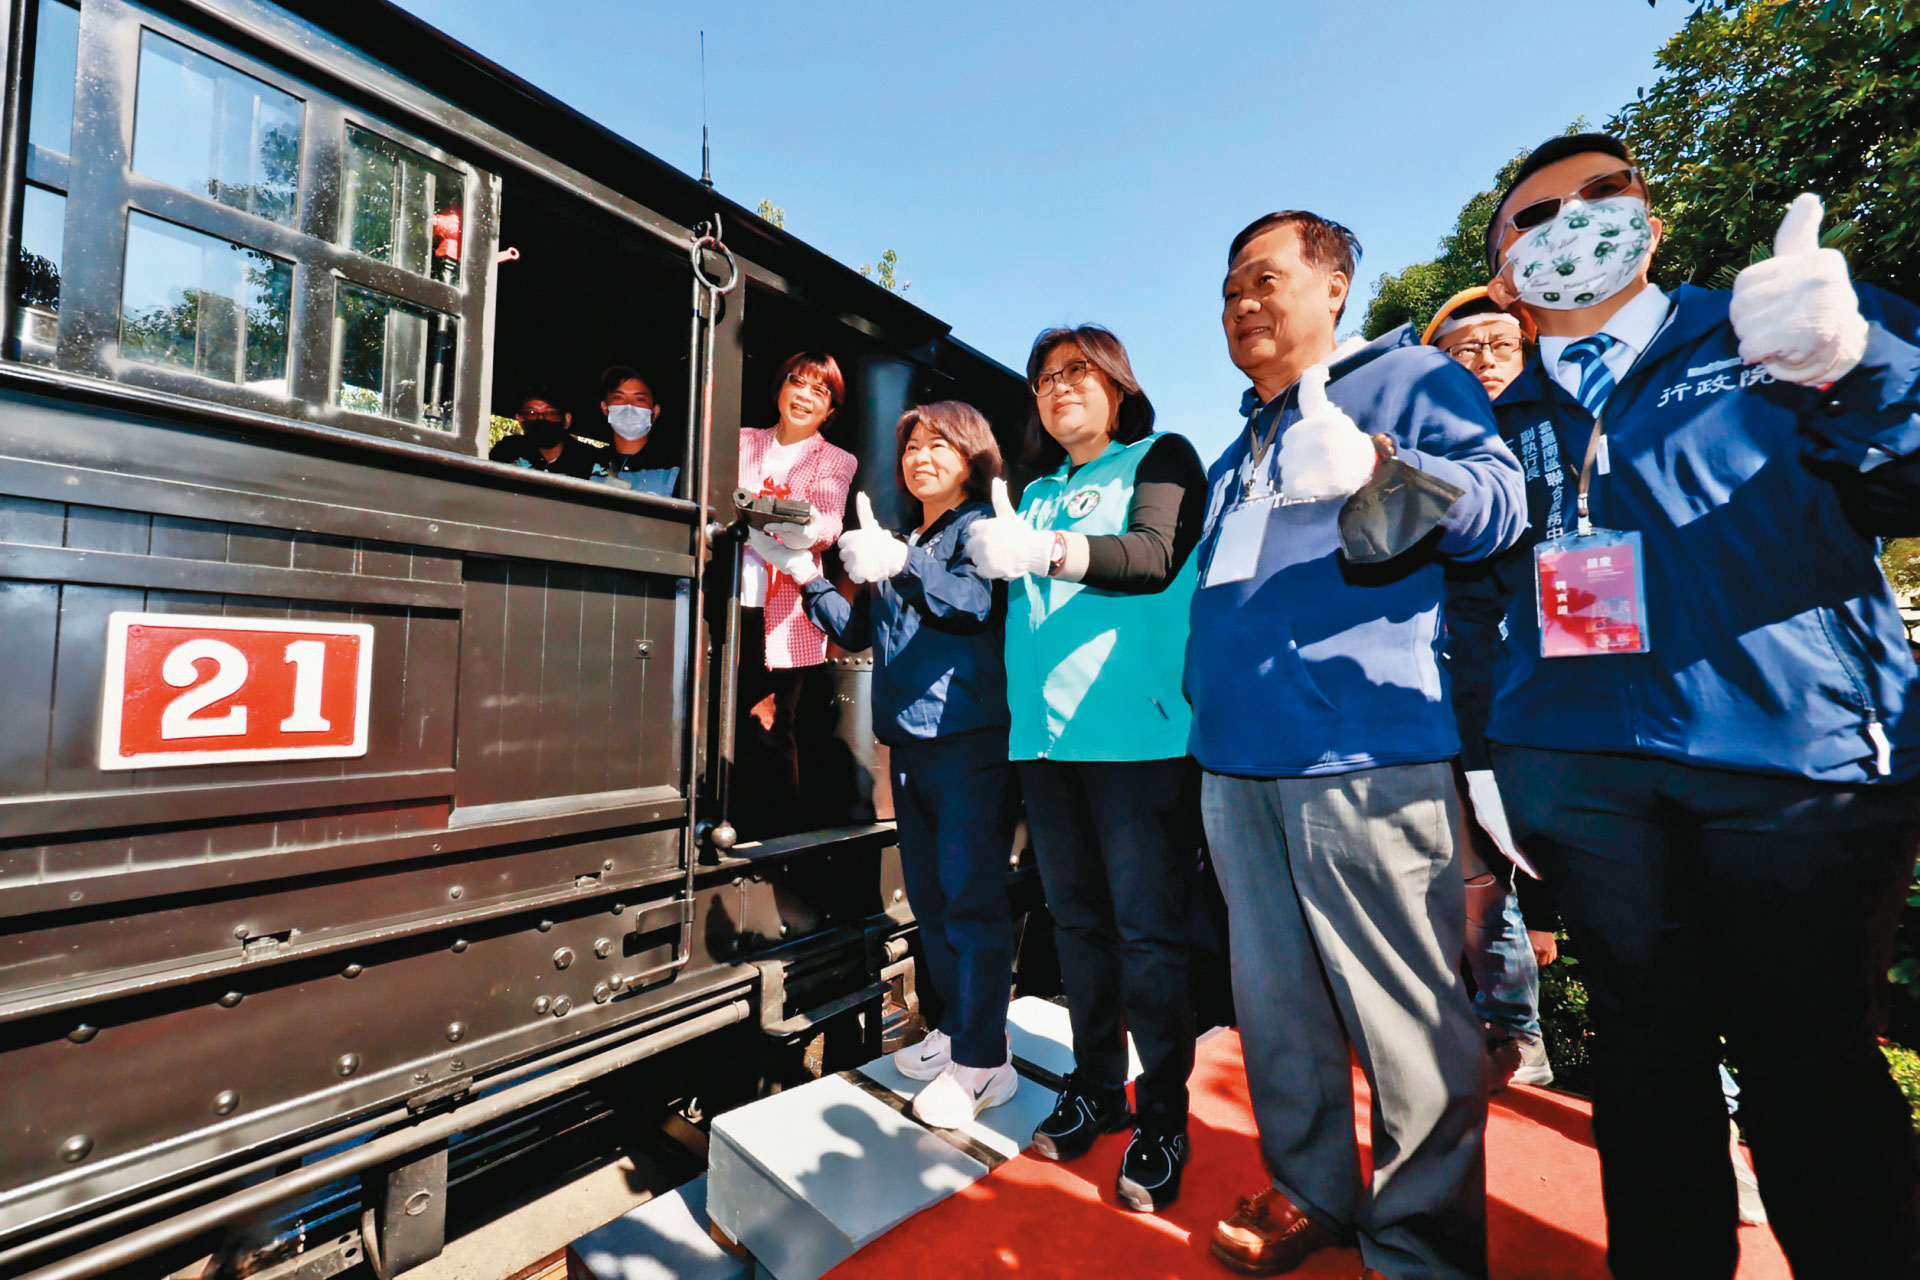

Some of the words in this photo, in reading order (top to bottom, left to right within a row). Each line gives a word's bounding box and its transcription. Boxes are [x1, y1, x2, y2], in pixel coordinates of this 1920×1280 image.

[1657, 365, 1776, 407] 行政院
[160, 638, 331, 740] 21
